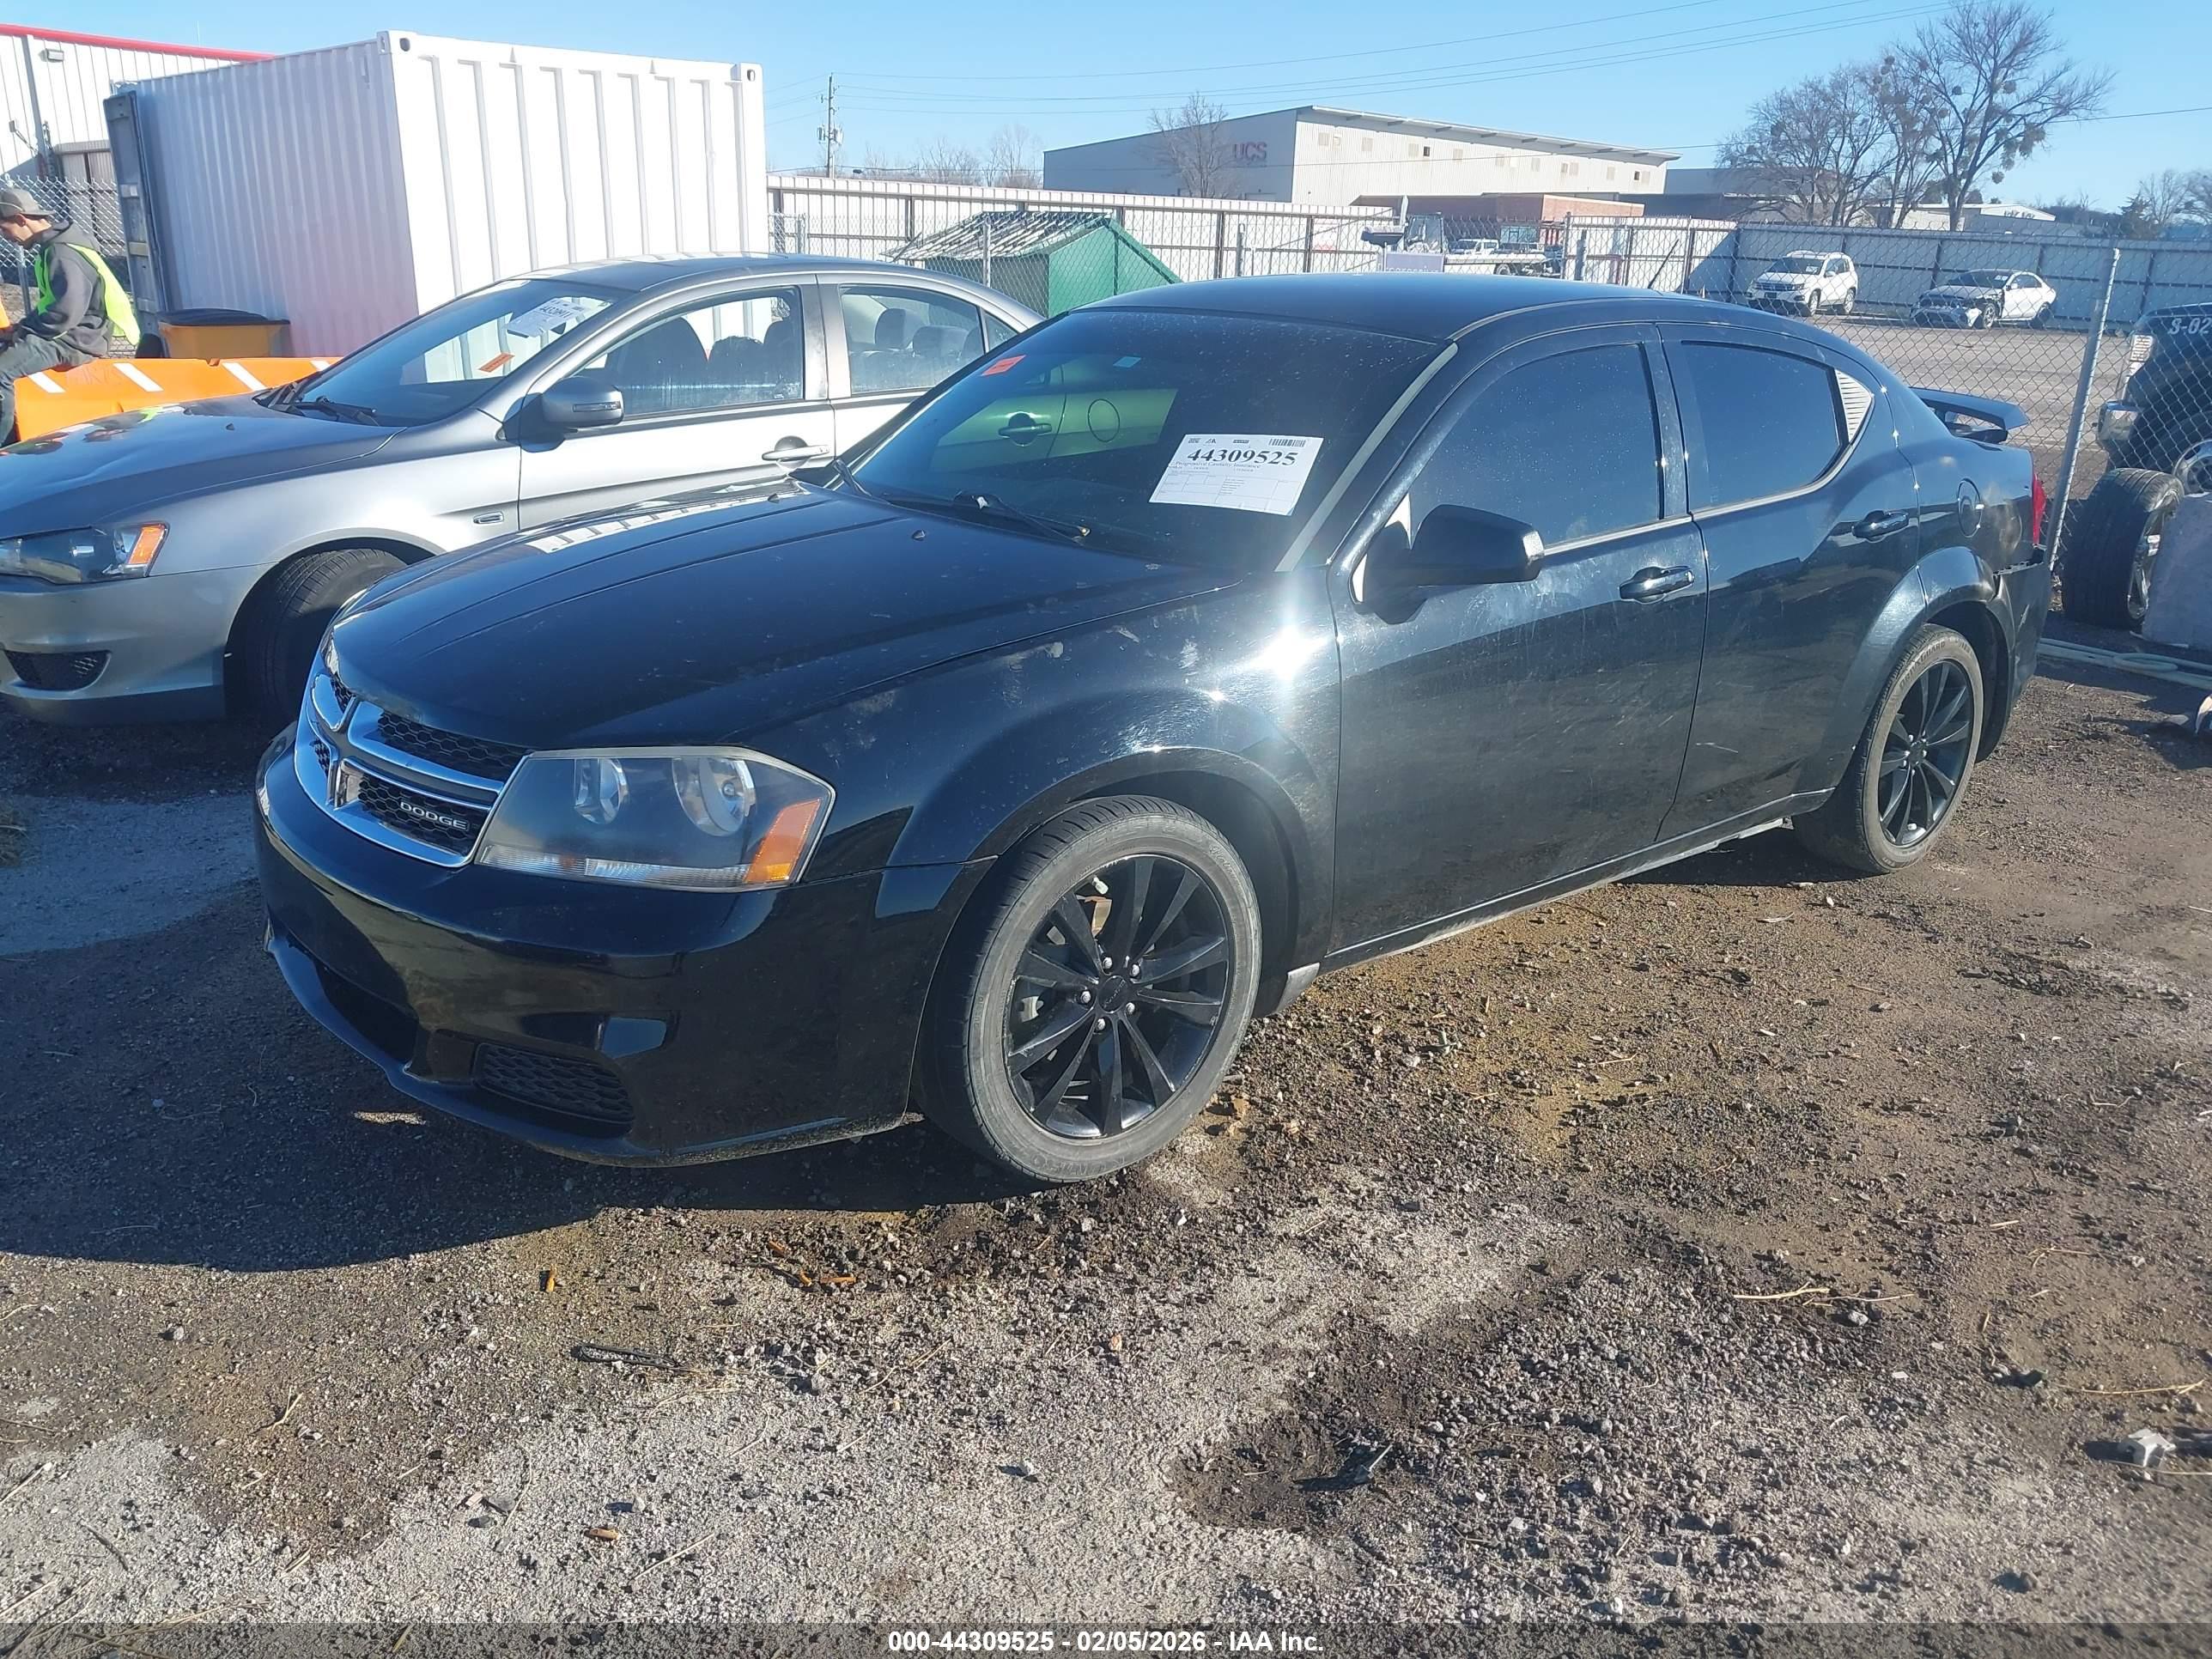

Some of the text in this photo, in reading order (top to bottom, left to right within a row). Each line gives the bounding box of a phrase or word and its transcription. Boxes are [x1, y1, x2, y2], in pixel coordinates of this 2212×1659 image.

[1233, 141, 1267, 161] UCS
[1186, 447, 1299, 466] 44309525
[400, 801, 467, 830] DODGE
